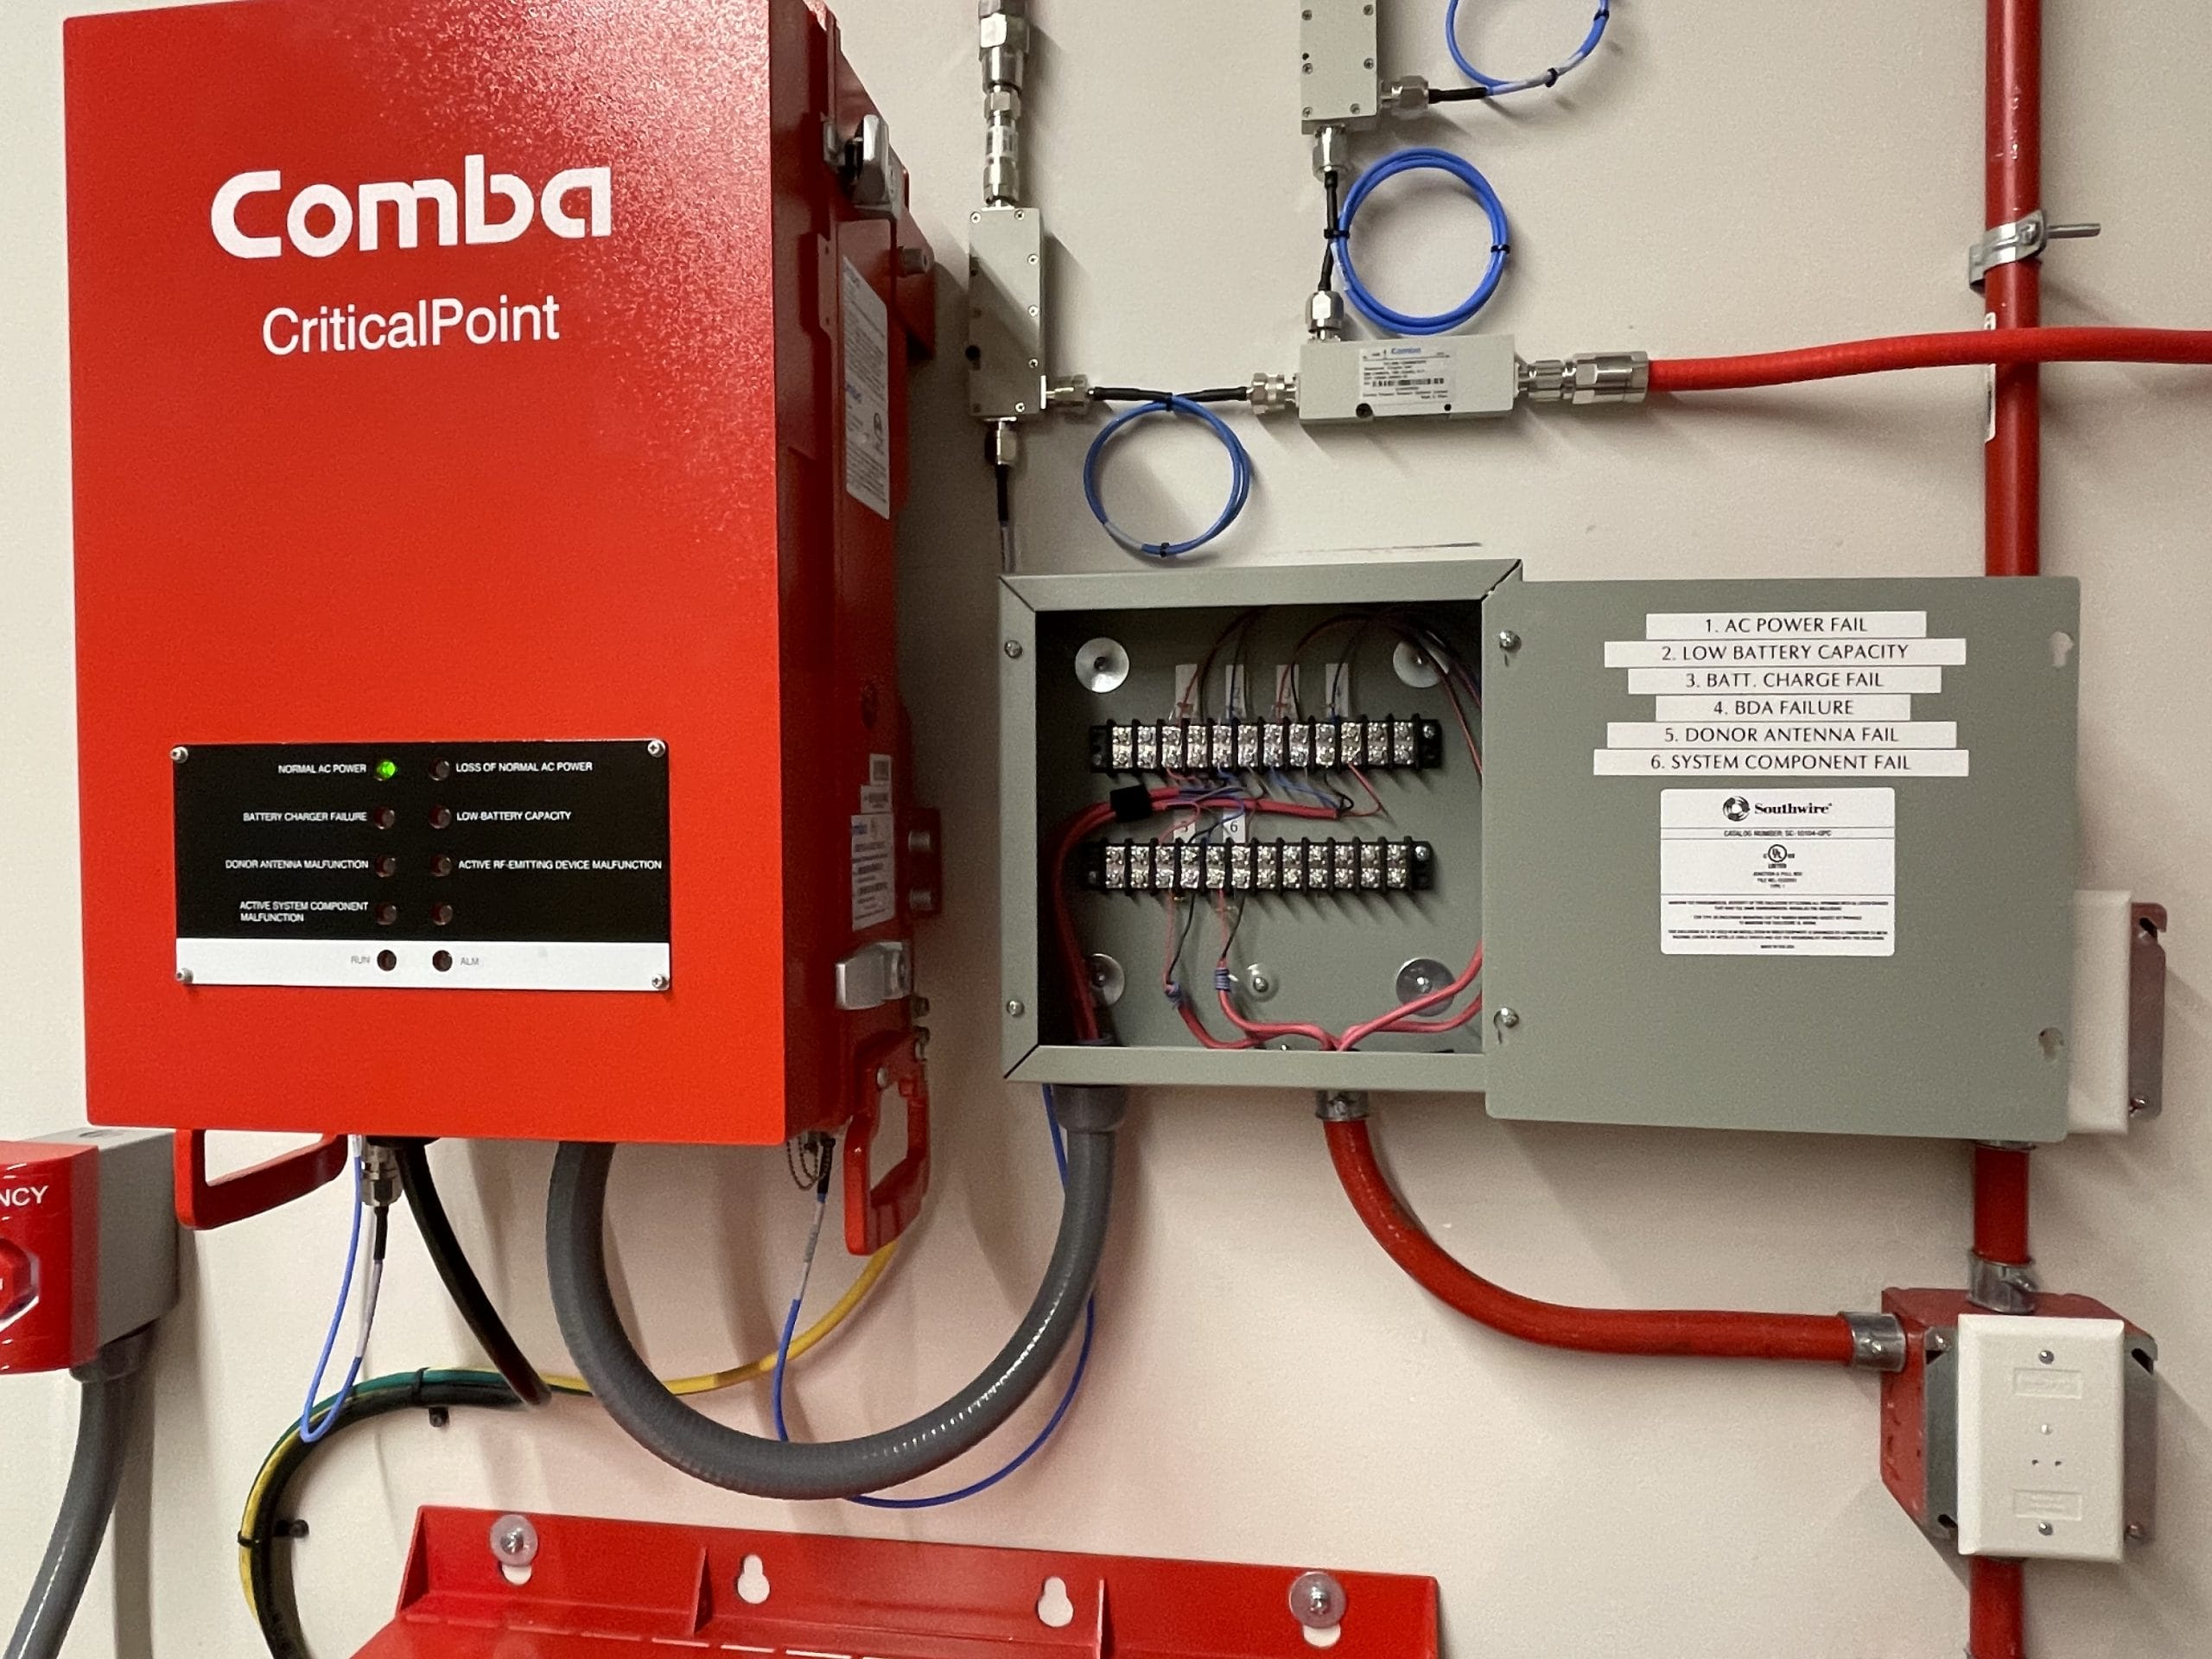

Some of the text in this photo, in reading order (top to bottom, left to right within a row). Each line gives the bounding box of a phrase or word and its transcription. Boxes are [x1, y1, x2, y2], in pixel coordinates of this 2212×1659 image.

[210, 154, 612, 259] Comba
[262, 294, 561, 356] CriticalPoint
[1705, 617, 1868, 633] 1. AC POWER FAIL
[1662, 644, 1910, 661] 2. LOW BATTERY CAPACITY
[1685, 672, 1885, 689] 3. BATT. CHARGE FAIL
[1713, 700, 1854, 715] 4. BDA FAILURE
[1664, 727, 1899, 742] 5. DONOR ANTENNA FAIL
[455, 761, 593, 772] LOSS OF NORMAL AC POWER
[1650, 754, 1912, 770] 6. SYSTEM COMPONENT FAIL
[277, 764, 367, 774] NORMAL AC POWER
[1754, 802, 1830, 815] Southwire
[243, 811, 368, 822] BATTERY CHARGER FAILURE
[456, 810, 572, 822] LOW-BATTERY CAPACITY
[1230, 820, 1238, 833] 6
[225, 860, 369, 869] DONOR ANTENNA MALFUNCTION
[458, 860, 663, 870] ACTIVE RF-EMITTING DEVICE MALFUNCTION
[239, 900, 369, 911] ACTIVE SYSTEM COMPONENT
[240, 912, 304, 922] MALFUNCTION
[351, 956, 371, 964] RUN
[460, 957, 480, 967] ALM
